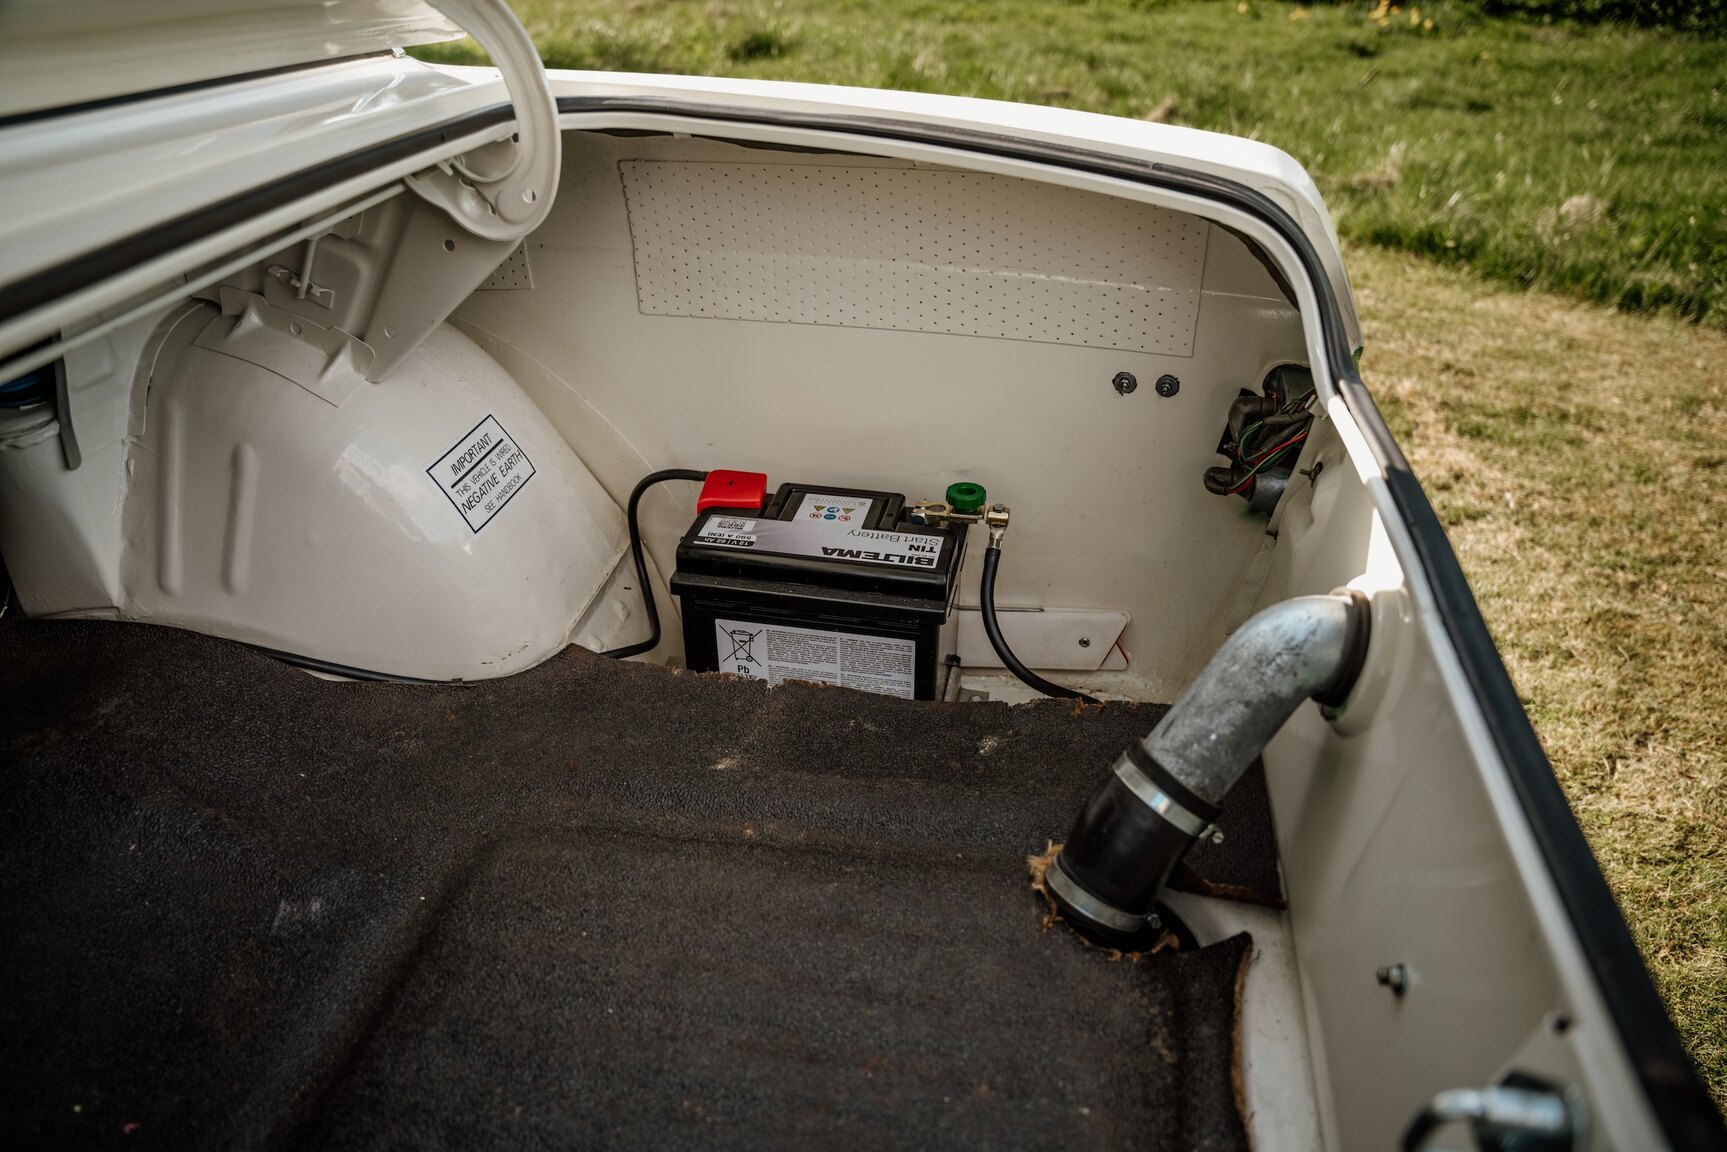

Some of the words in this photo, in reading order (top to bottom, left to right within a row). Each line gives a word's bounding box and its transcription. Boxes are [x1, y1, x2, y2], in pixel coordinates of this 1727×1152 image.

[450, 432, 493, 476] IMPORTANT
[455, 482, 472, 498] THIS
[469, 463, 492, 485] VEHICLE
[489, 458, 497, 467] IS
[495, 443, 512, 461] WIRED
[461, 472, 500, 515] NEGATIVE
[498, 449, 523, 478] EARTH
[484, 501, 497, 514] SEE
[495, 473, 523, 503] HANDBOOK
[847, 528, 901, 543] Battery
[904, 536, 940, 546] Start
[821, 546, 934, 566] BILTEMA
[908, 544, 937, 554] TIN
[737, 664, 750, 674] Pb
